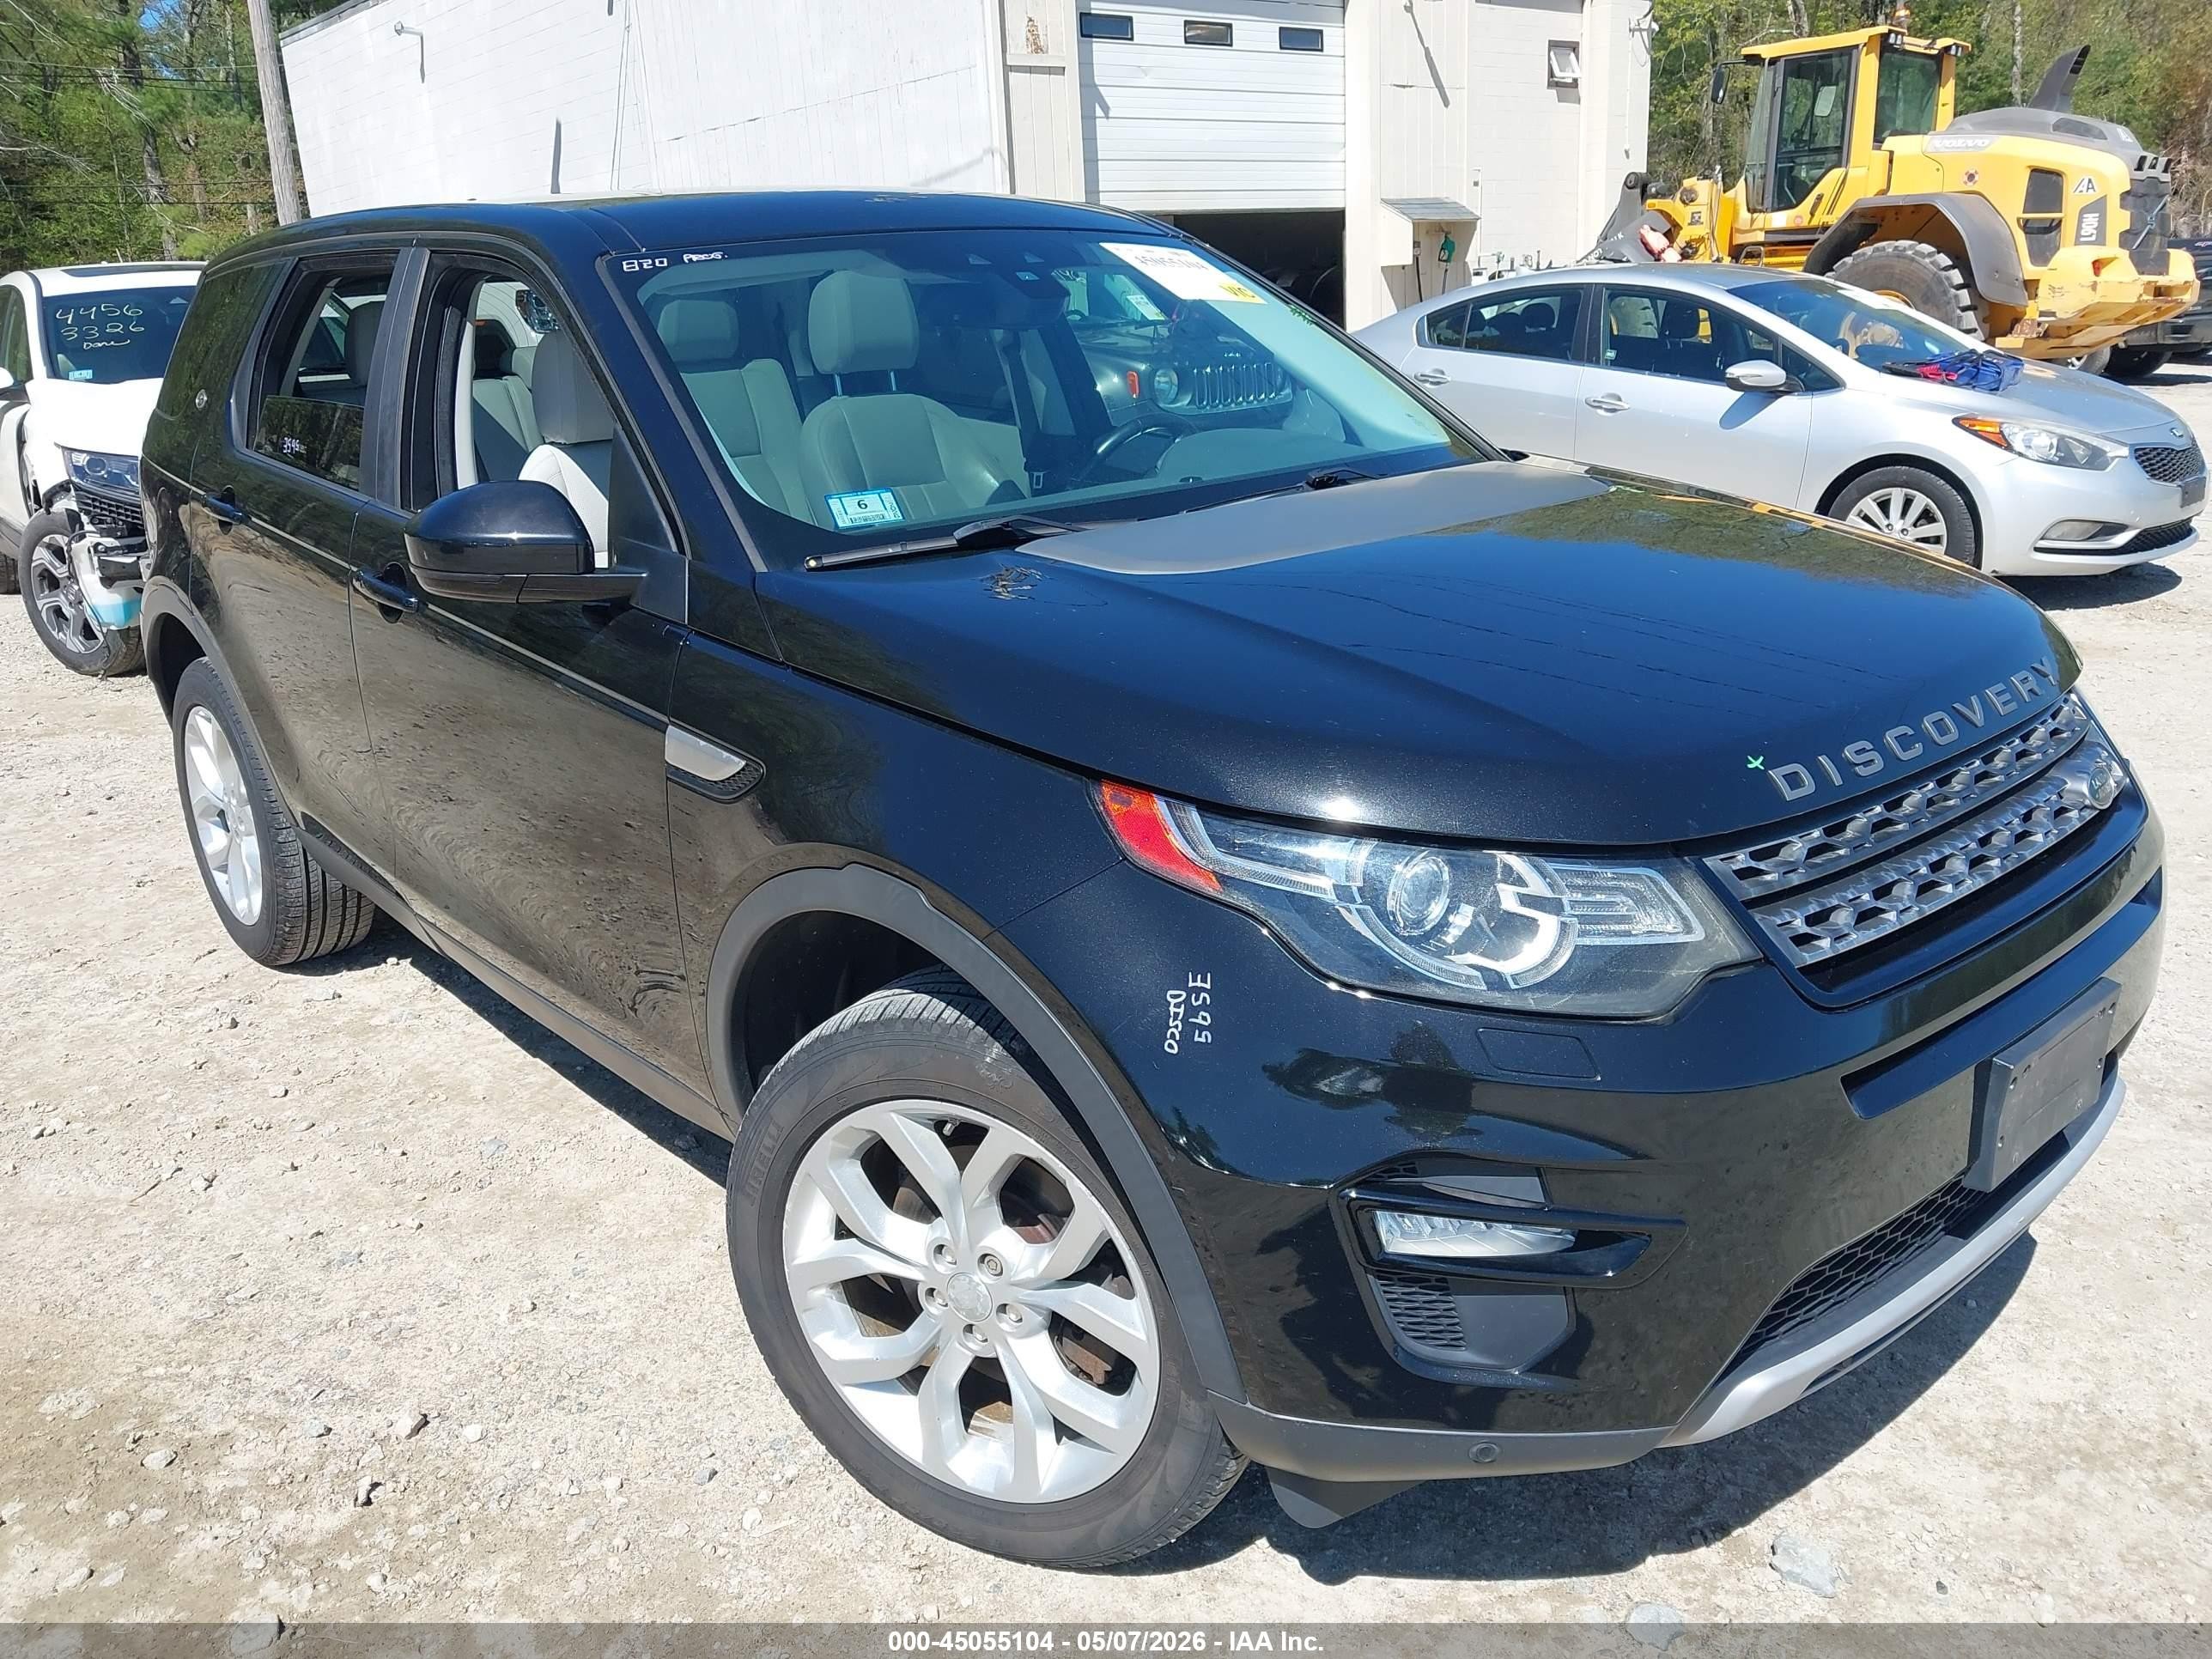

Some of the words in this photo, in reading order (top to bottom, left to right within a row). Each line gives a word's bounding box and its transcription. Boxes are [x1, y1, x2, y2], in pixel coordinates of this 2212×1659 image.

[1934, 138, 1990, 148] VOLVO
[2079, 212, 2100, 242] L90H
[55, 303, 143, 325] 4456
[60, 320, 145, 341] 3326
[283, 436, 300, 454] 3595
[857, 499, 868, 510] 6
[1767, 655, 2060, 801] DISCOVERY
[1164, 989, 1187, 1055] DISCO
